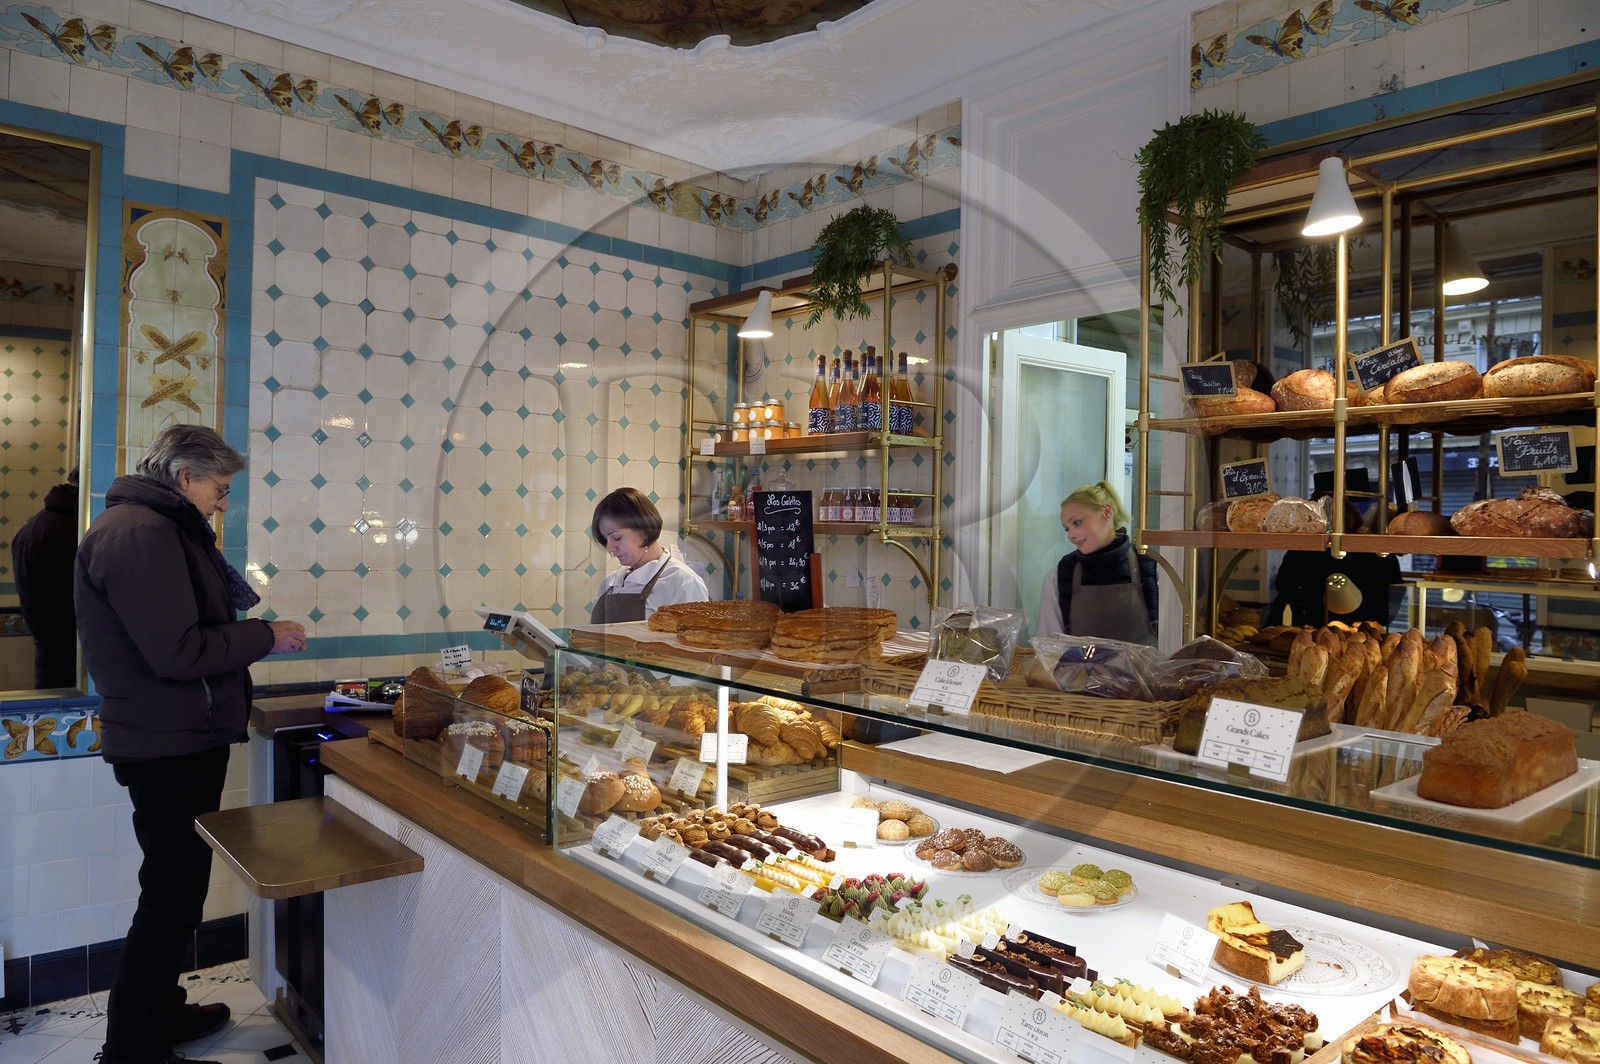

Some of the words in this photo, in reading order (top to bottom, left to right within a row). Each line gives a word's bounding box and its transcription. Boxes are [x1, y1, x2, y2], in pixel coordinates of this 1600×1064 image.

[1226, 724, 1249, 736] Grands
[1250, 728, 1270, 740] Cakes
[1021, 1018, 1033, 1031] Tarte
[1033, 1027, 1049, 1038] citron
